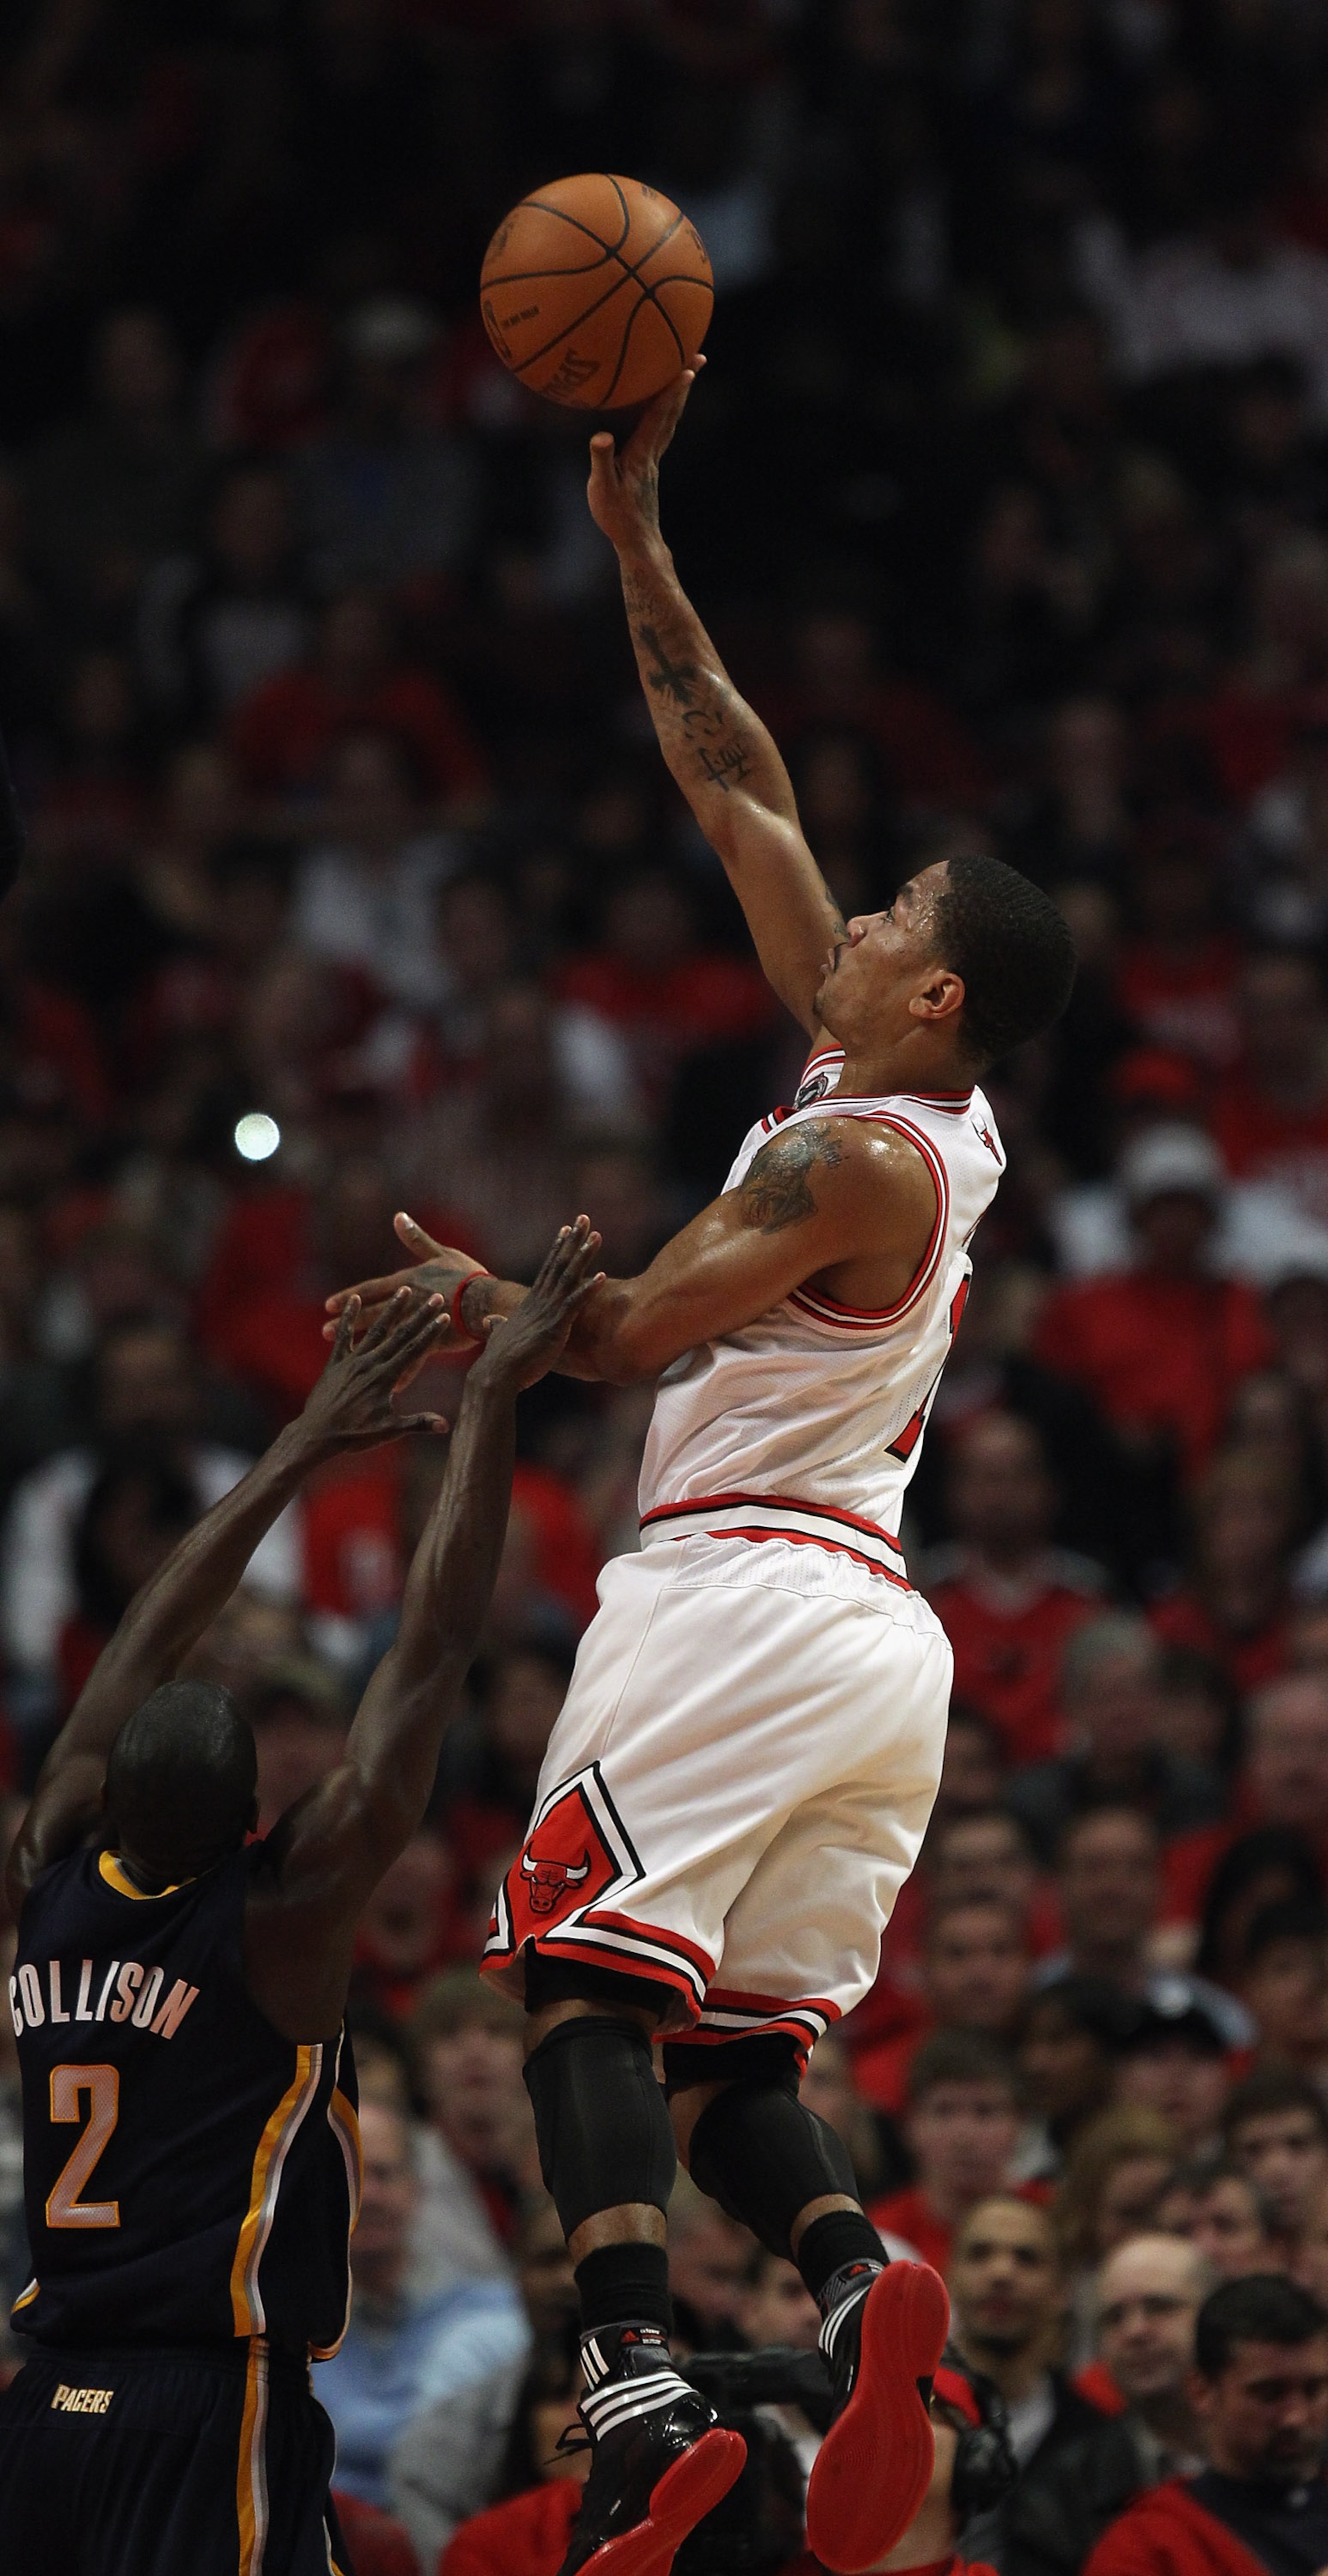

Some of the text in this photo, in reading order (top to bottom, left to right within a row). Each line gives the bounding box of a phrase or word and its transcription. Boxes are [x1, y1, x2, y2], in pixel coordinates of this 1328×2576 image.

[9, 1958, 201, 2040] COLLISON
[45, 2064, 121, 2228] 2
[51, 2383, 114, 2414] PACERS
